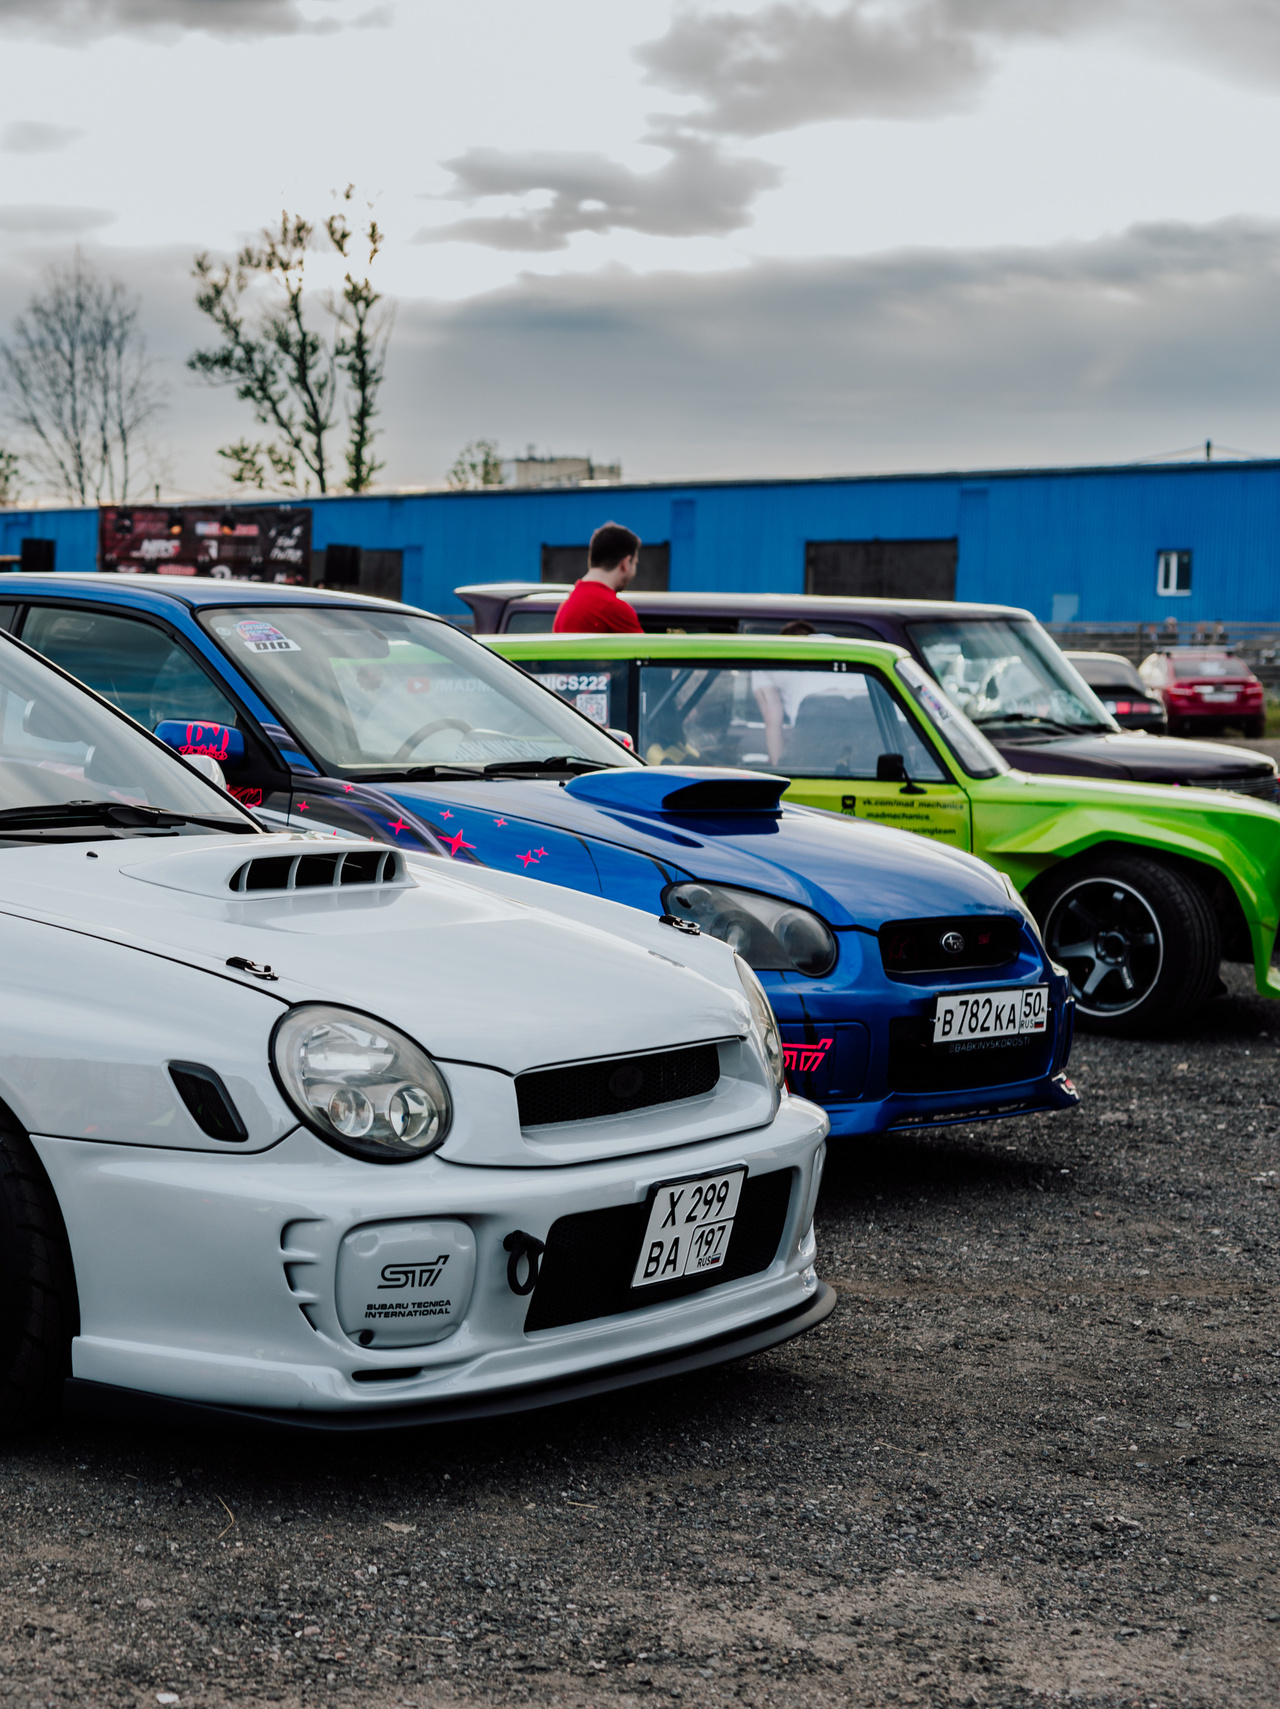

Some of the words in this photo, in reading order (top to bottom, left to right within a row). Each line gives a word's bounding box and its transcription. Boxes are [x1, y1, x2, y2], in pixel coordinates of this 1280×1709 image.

[1023, 991, 1042, 1018] 50
[1021, 1018, 1034, 1030] RUS
[684, 1180, 729, 1224] 299
[694, 1224, 726, 1258] 197
[696, 1255, 712, 1268] RUS
[366, 1302, 409, 1311] SUBARU
[411, 1299, 451, 1309] TECNICA
[364, 1307, 451, 1319] INTERNATIONAL
